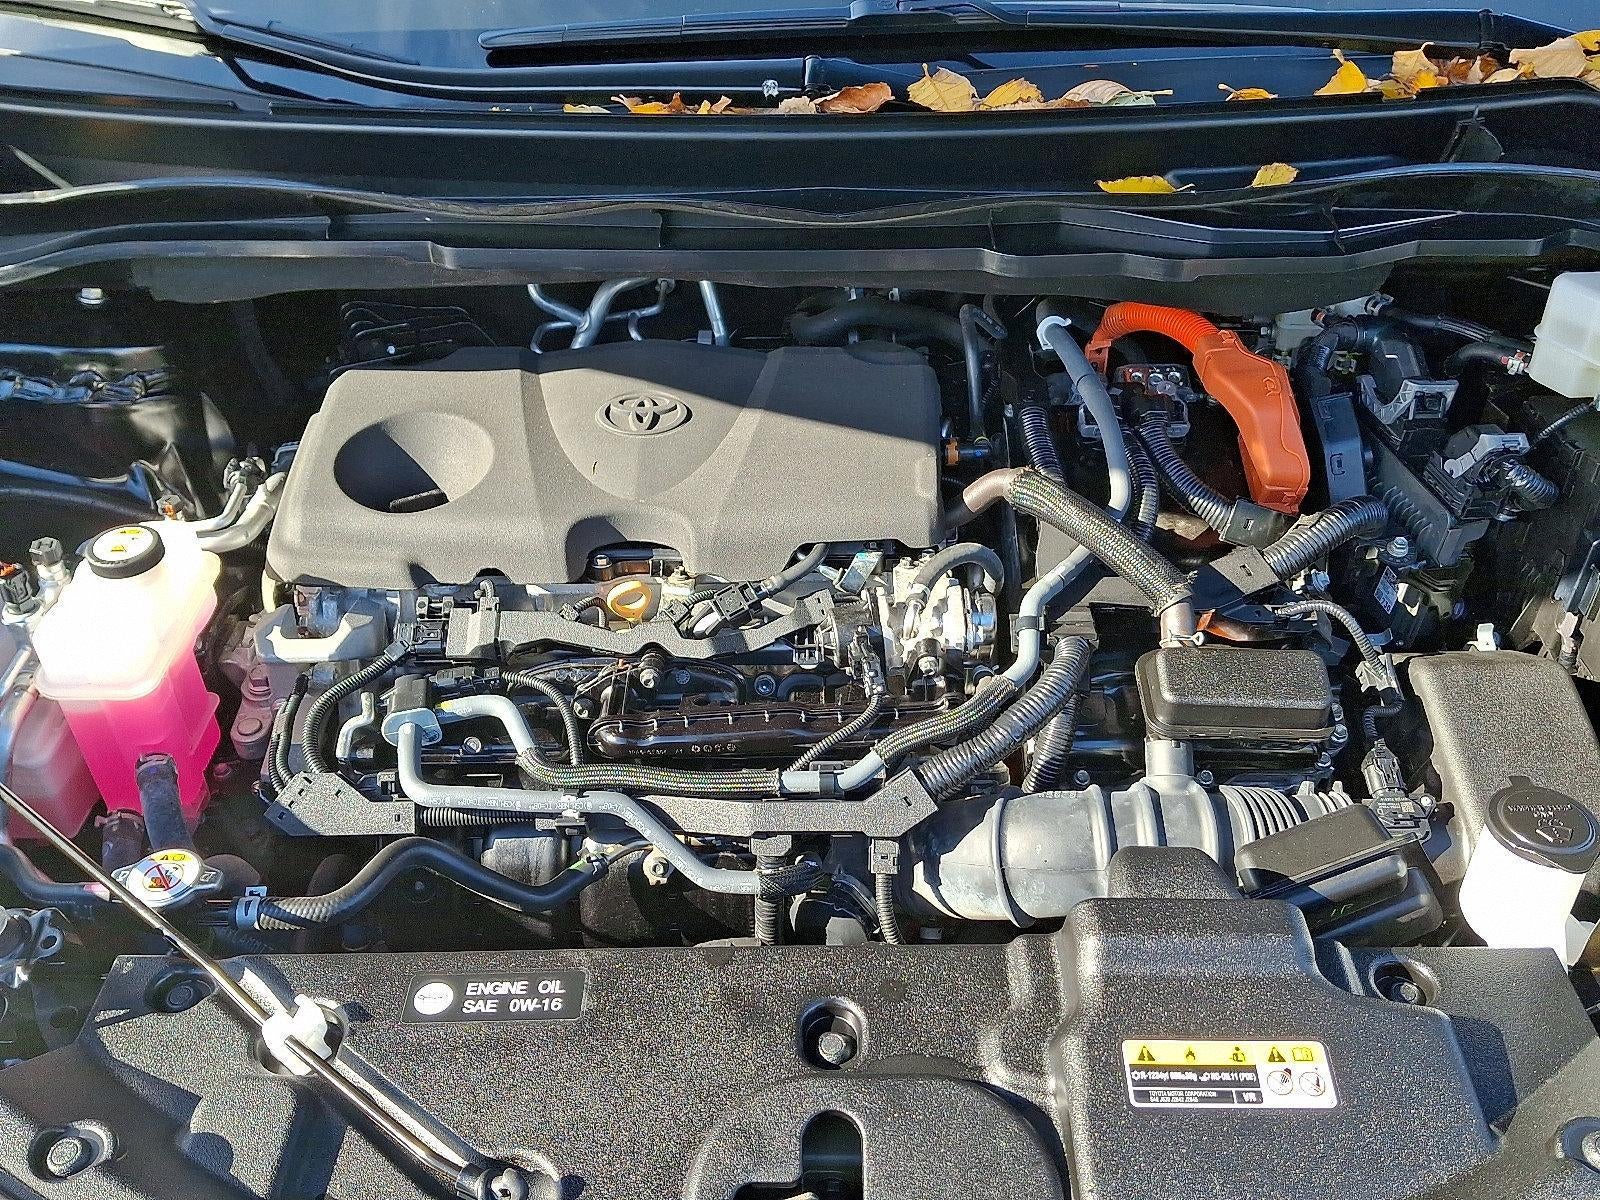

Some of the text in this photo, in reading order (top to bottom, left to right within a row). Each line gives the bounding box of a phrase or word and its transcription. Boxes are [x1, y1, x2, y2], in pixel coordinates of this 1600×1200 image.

[466, 980, 566, 995] ENGINE OIL
[462, 998, 562, 1013] SAE 0W-16
